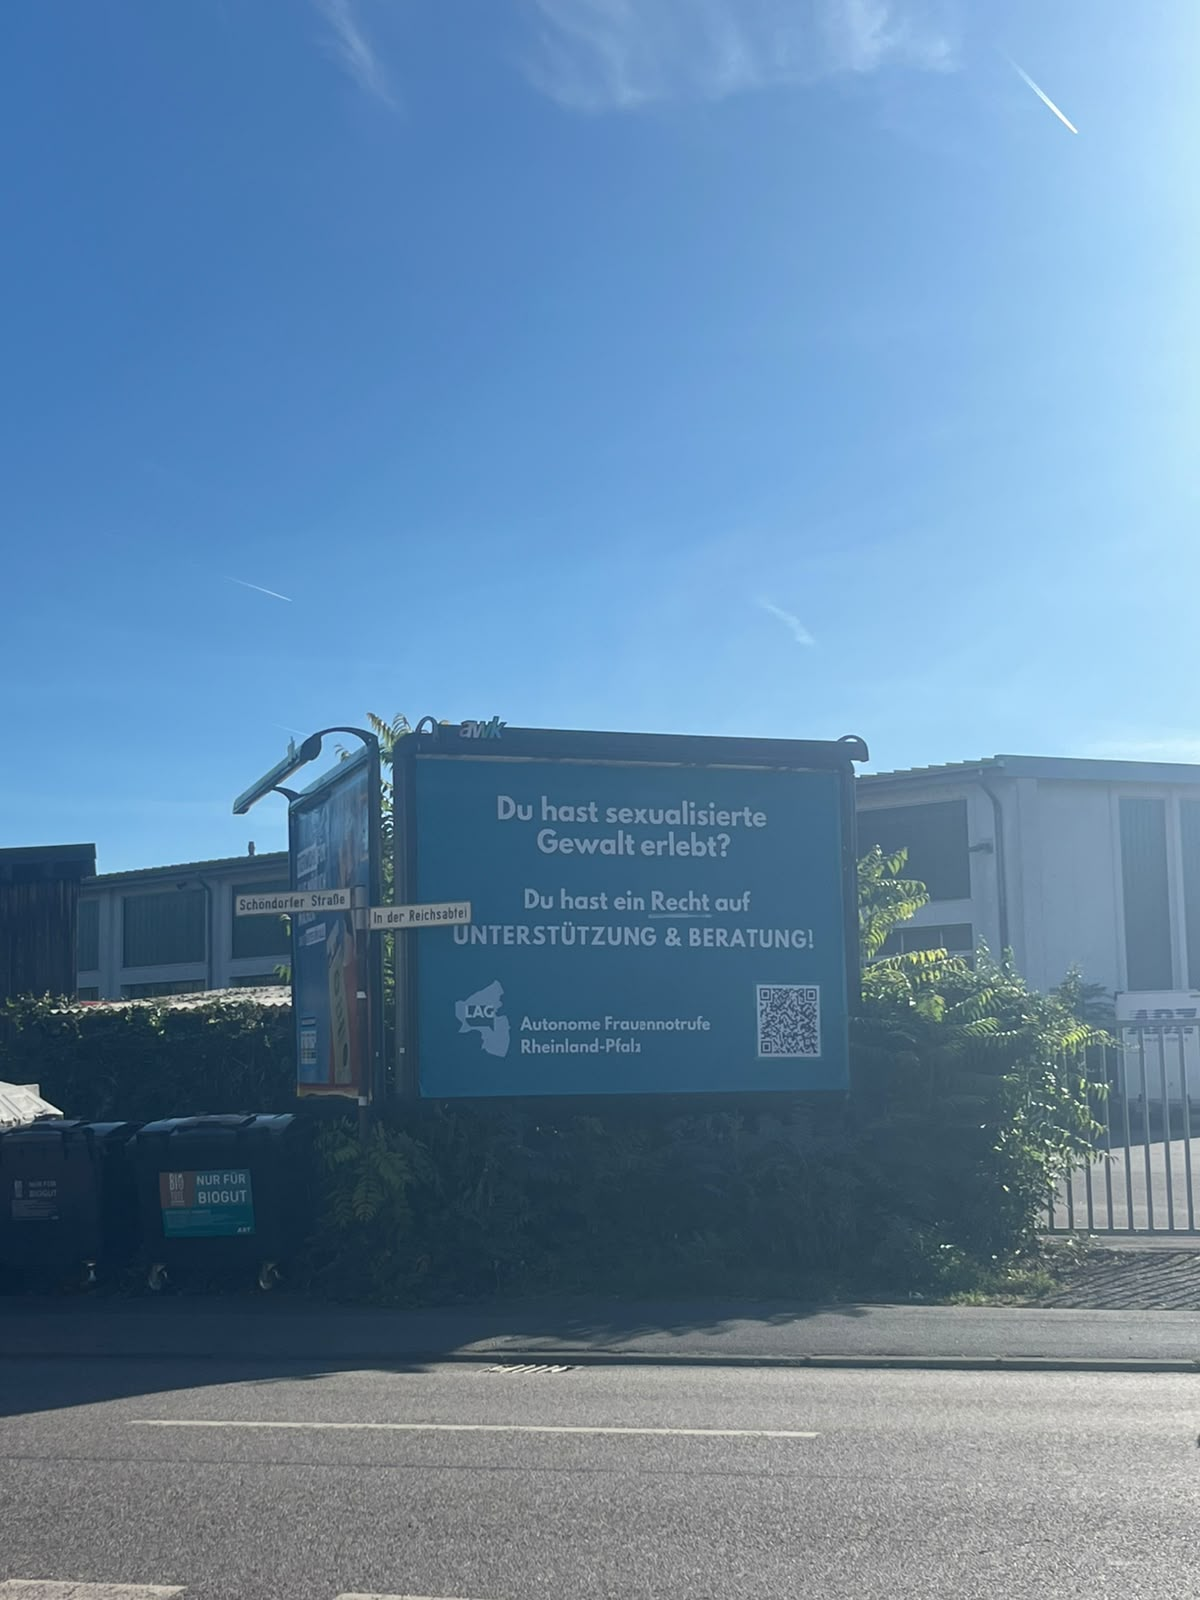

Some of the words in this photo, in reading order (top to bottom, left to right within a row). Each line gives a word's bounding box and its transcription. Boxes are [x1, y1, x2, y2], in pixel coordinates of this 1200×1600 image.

[458, 715, 507, 738] awk
[496, 796, 533, 822] Du
[541, 796, 599, 824] hast
[605, 800, 767, 828] sexualisierte
[536, 829, 635, 856] Gewalt
[640, 832, 732, 858] erlebt?
[239, 897, 305, 911] Schöndorfer
[311, 893, 346, 907] Straße
[523, 888, 554, 910] Du
[560, 889, 608, 911] hast
[614, 890, 645, 911] ein
[651, 891, 710, 912] Recht
[715, 890, 751, 912] auf
[373, 914, 382, 925] In
[387, 911, 405, 923] der
[409, 908, 468, 922] Reichsabtei
[453, 923, 657, 947] UNTERSTÜTZUNG
[665, 928, 682, 947] &
[689, 928, 815, 950] BERATUNG!
[465, 1004, 495, 1018] LAG
[520, 1016, 601, 1031] Autonome
[604, 1016, 711, 1031] Frauennotrufe
[520, 1038, 641, 1055] Rheinland-Pfalz
[196, 1175, 220, 1186] NUR
[223, 1172, 246, 1184] FÜR
[197, 1190, 247, 1204] BIOGUT
